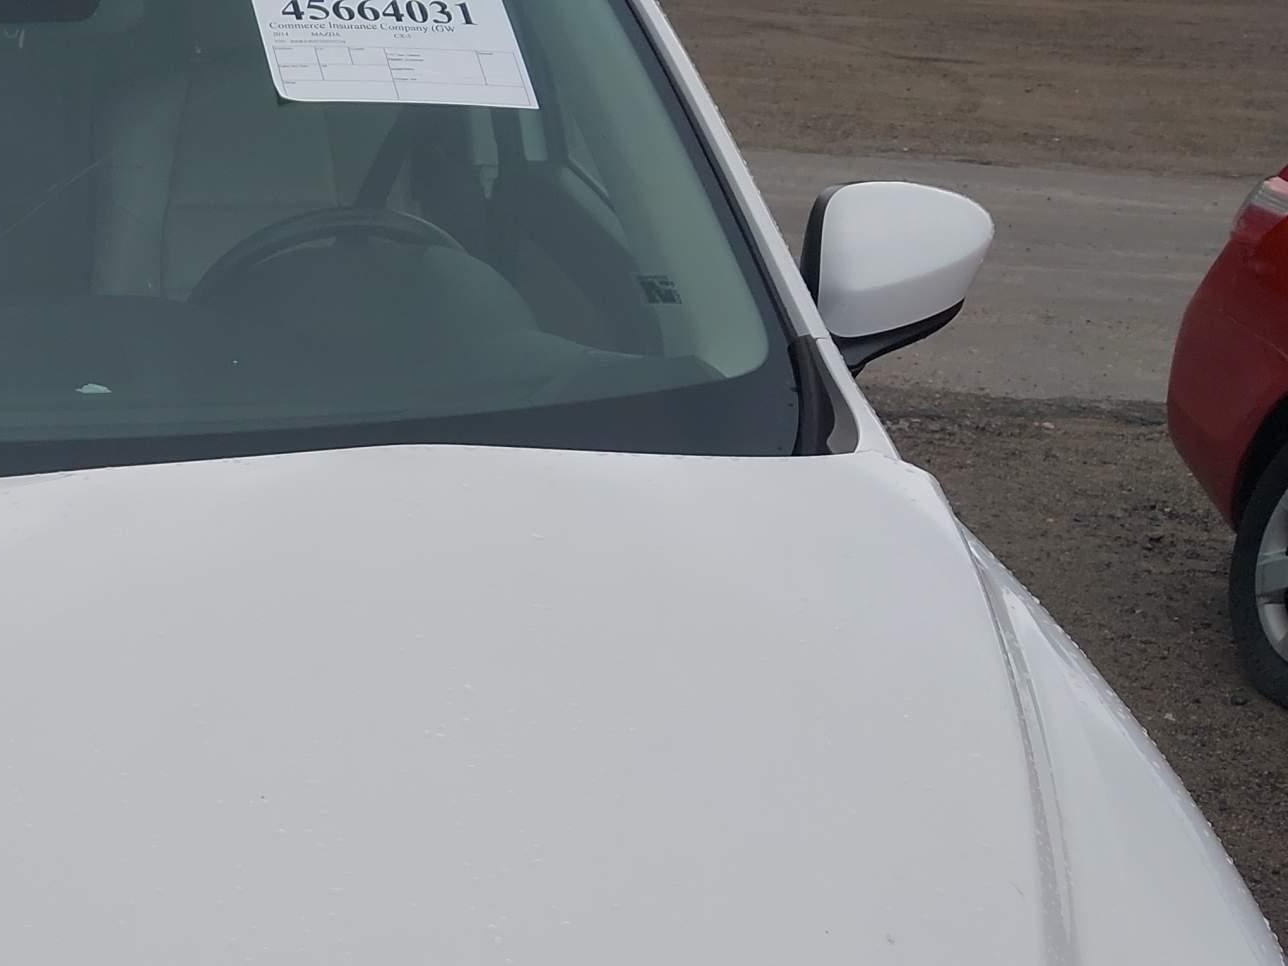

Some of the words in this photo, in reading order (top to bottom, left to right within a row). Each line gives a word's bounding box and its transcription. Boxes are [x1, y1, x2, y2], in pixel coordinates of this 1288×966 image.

[281, 0, 478, 26] 45664031
[269, 21, 326, 30] Commerce
[328, 22, 377, 31] Insurance
[380, 23, 428, 33] Company
